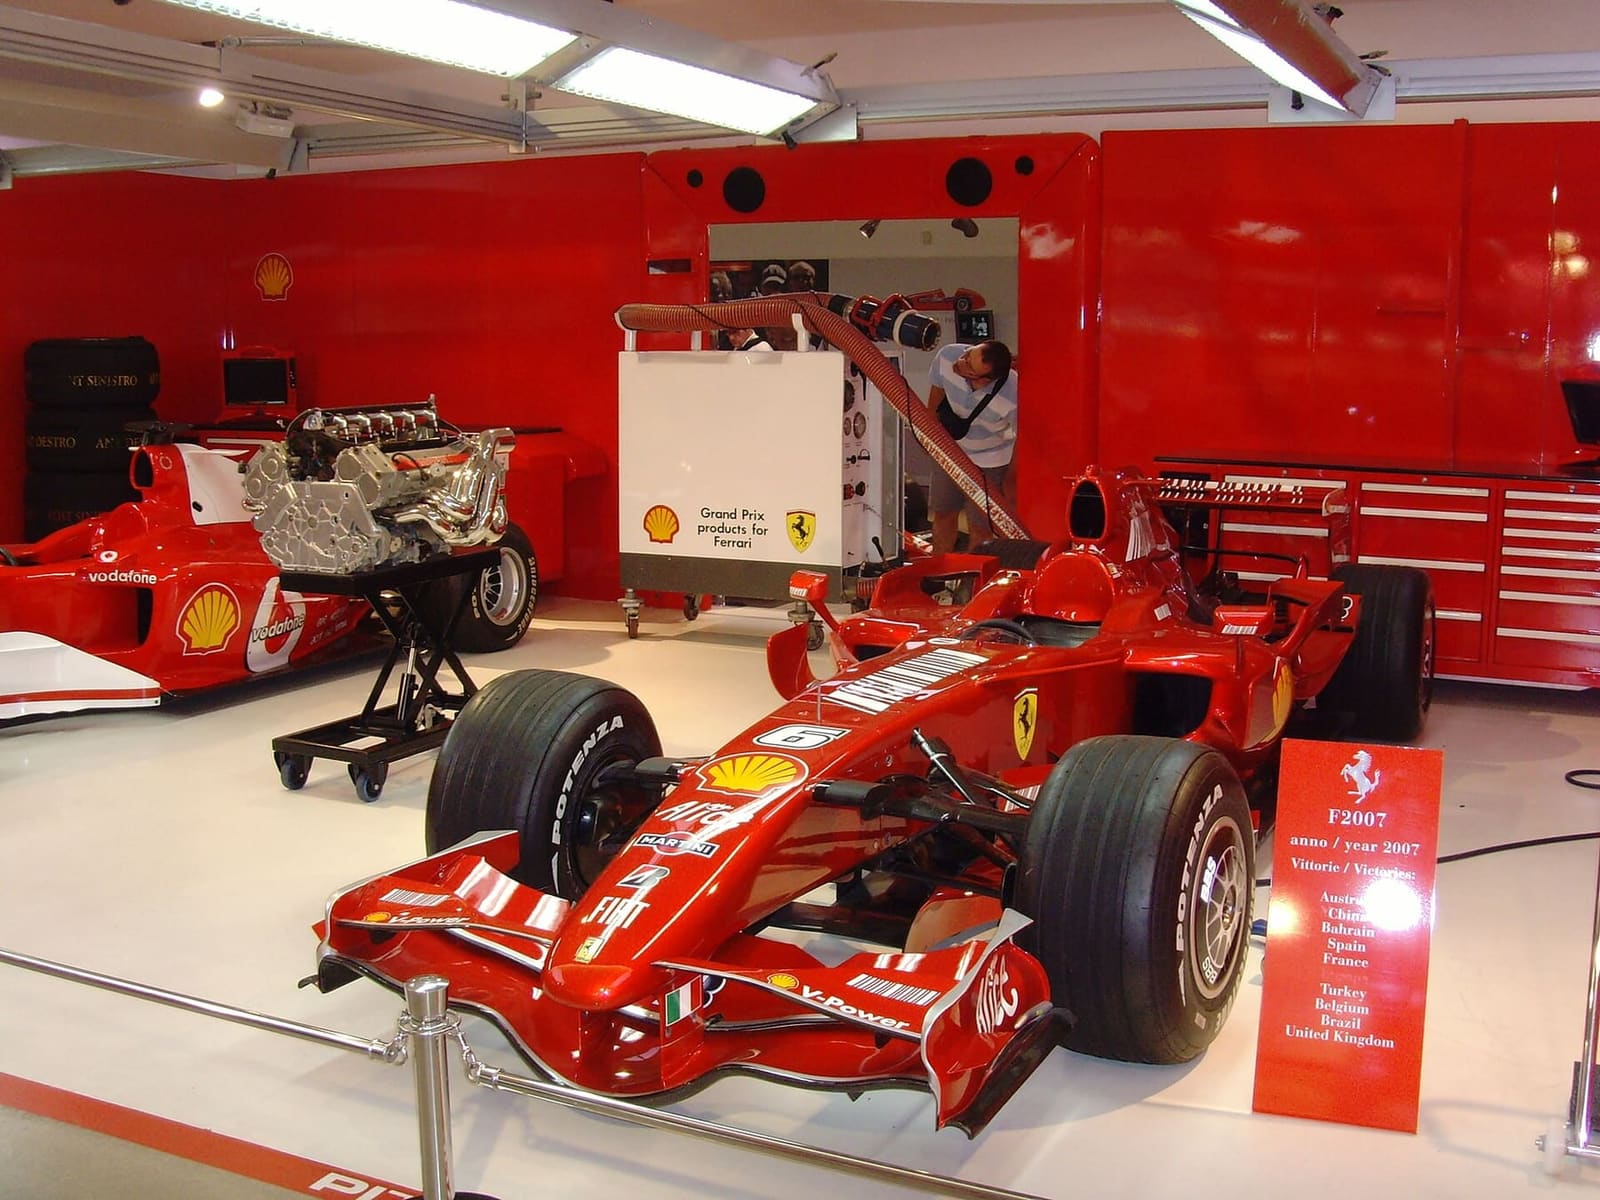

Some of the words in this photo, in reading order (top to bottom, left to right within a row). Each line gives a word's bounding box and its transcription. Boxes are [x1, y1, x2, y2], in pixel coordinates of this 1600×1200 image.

[700, 507, 737, 520] Grand
[742, 509, 765, 521] Prix
[697, 522, 747, 535] products
[752, 523, 769, 536] for
[714, 536, 752, 548] Ferrari
[89, 570, 157, 584] vodafone
[252, 613, 304, 642] vodafone
[753, 724, 852, 750] 6
[552, 715, 624, 845] POTENZA
[1328, 808, 1387, 828] F2007
[641, 836, 712, 854] MARTINI
[1290, 835, 1328, 848] anno
[1333, 837, 1340, 849] /
[1344, 841, 1378, 853] year
[1383, 841, 1421, 856] 2007
[1176, 783, 1223, 952] POTENZA
[1290, 857, 1340, 873] Vittorie
[1343, 862, 1350, 873] /
[1354, 863, 1416, 880] Victories:
[1200, 856, 1217, 904] BBS
[581, 896, 650, 929] FIAT
[1321, 921, 1376, 938] Bahrain
[1327, 938, 1366, 953] Spain
[1322, 953, 1369, 968] France
[1320, 983, 1367, 1002] Turkey
[801, 985, 910, 1030] V-Power
[1315, 998, 1369, 1015] Belgium
[1321, 1014, 1361, 1029] Brazil
[1285, 1024, 1329, 1041] United
[1334, 1030, 1395, 1049] Kingdom
